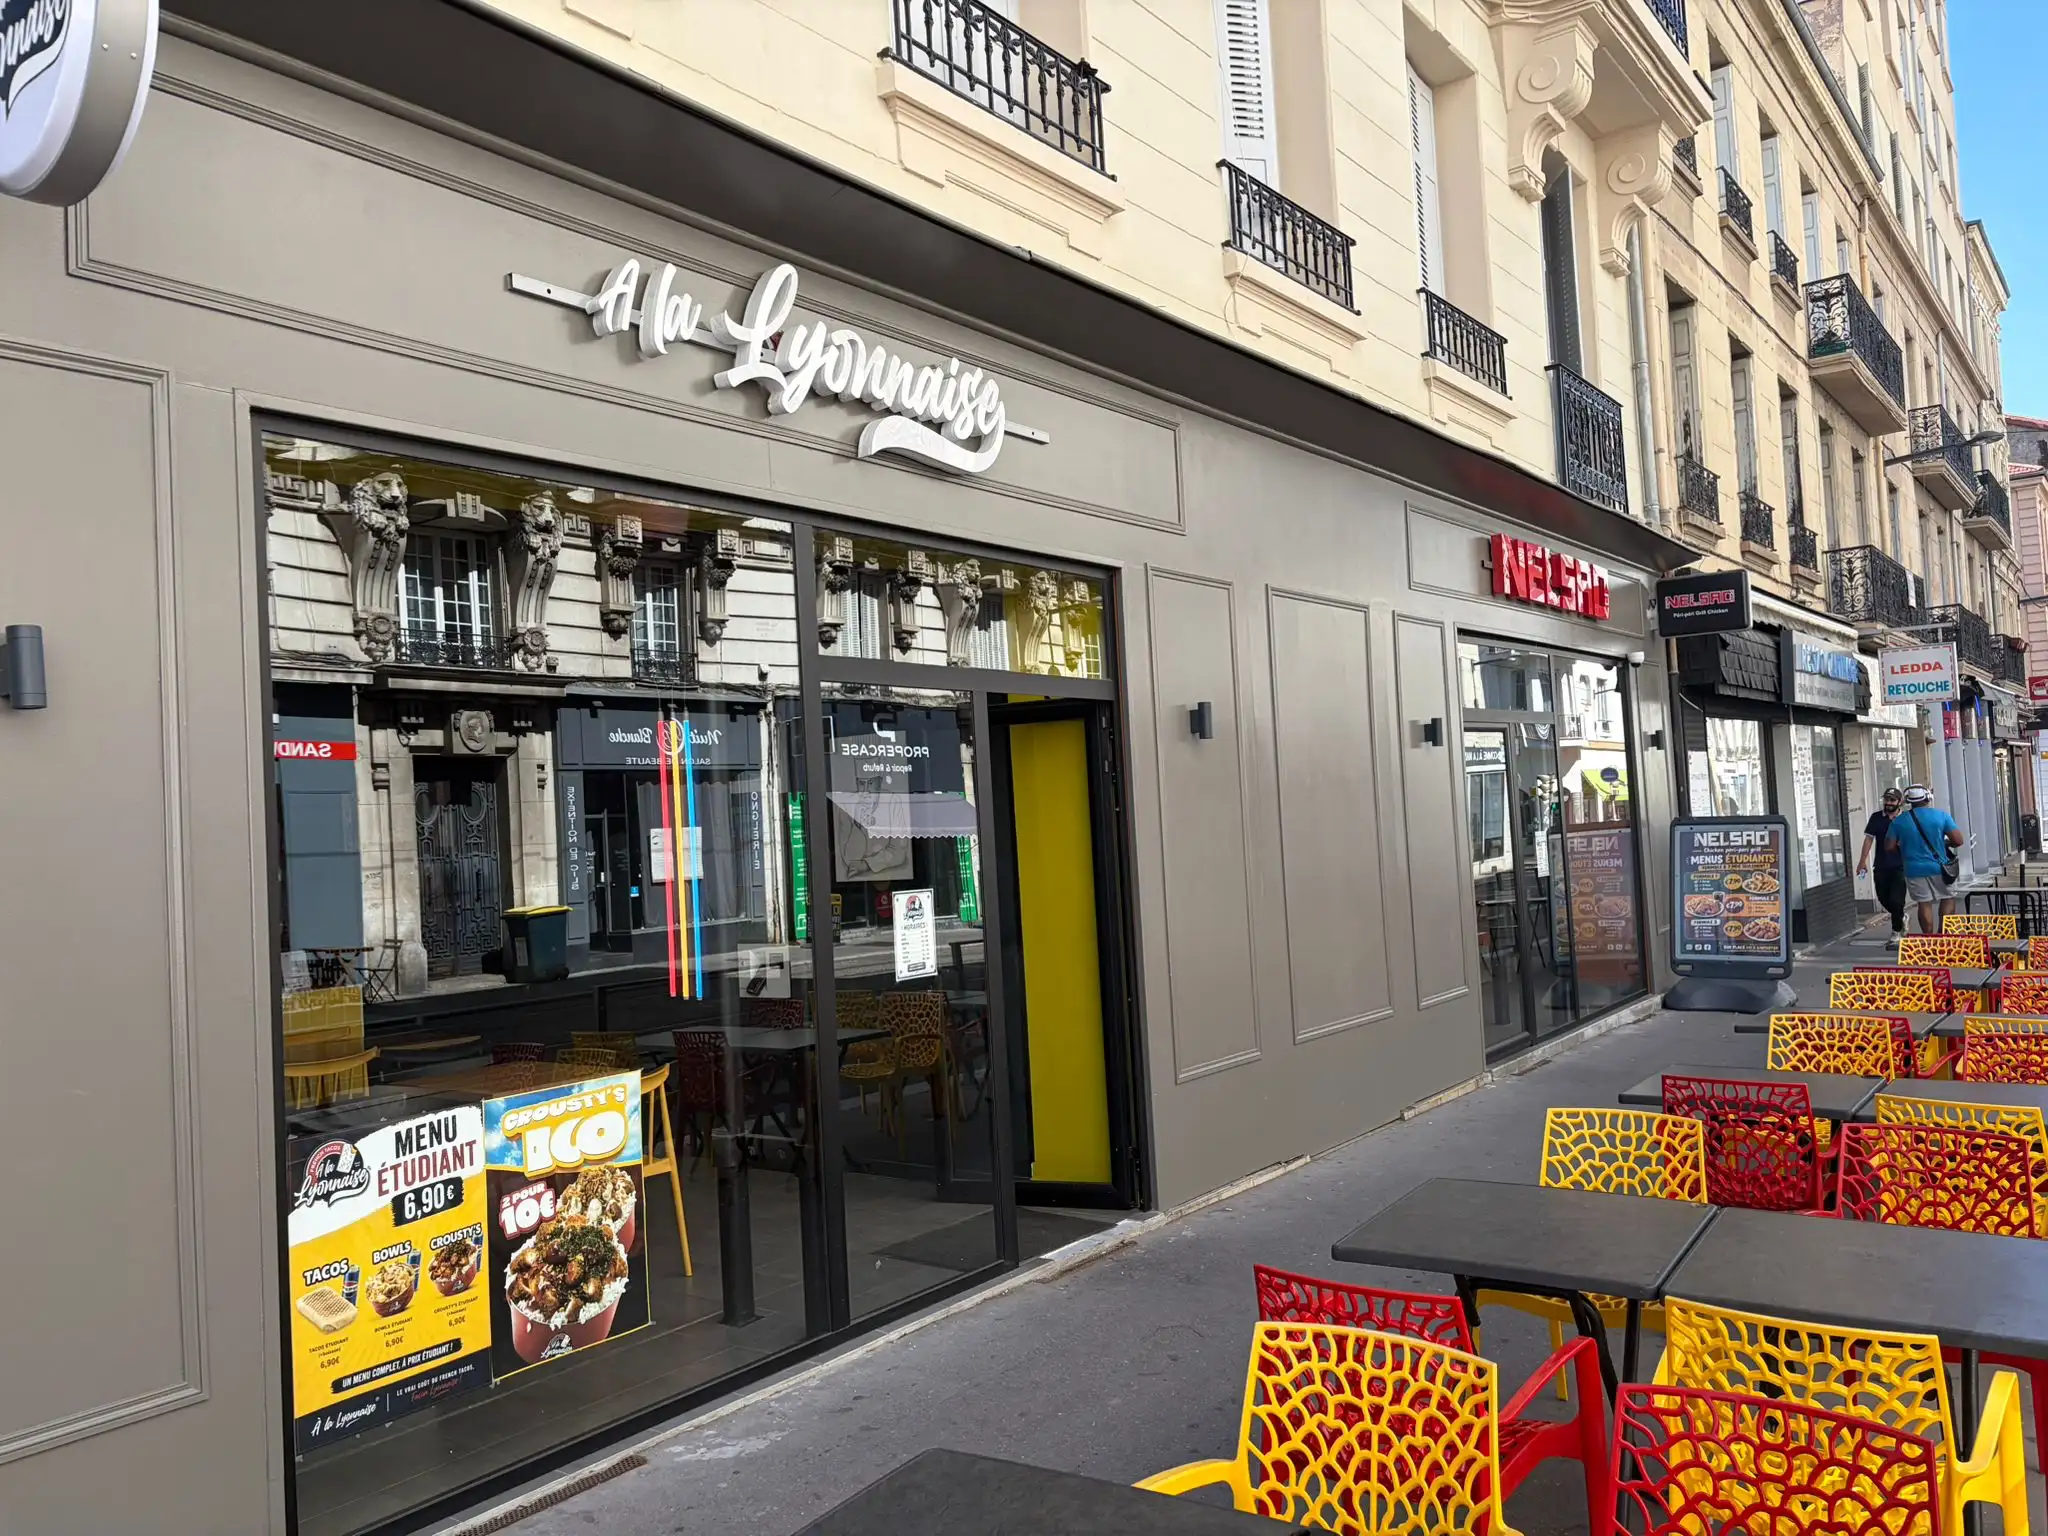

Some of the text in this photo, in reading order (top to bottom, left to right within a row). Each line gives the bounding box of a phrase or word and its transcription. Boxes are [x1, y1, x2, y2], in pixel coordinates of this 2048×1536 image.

[586, 259, 1006, 473] A la Lyonnaise
[1890, 661, 1944, 675] LEDDA
[1887, 680, 1950, 696] RETOUCHE
[1690, 853, 1776, 865] MENUS ÉTUDIANTS
[504, 1087, 625, 1131] CROUSTY'S
[395, 1115, 457, 1159] MENU
[309, 1145, 341, 1173] FRENCH TACOS
[377, 1140, 477, 1197] ÉTUDIANT
[294, 1169, 370, 1206] Lyonnaise
[502, 1183, 546, 1209] 2 POUR
[501, 1191, 554, 1235] 10€
[430, 1223, 482, 1249] CROUSTY'S
[373, 1241, 411, 1264] BOWLS
[304, 1260, 349, 1285] TACOS
[309, 1345, 325, 1353] TACOS
[385, 1335, 404, 1348] 6,90€
[320, 1356, 340, 1369] 6,90€
[342, 1376, 352, 1388] UN
[353, 1371, 371, 1385] MENU
[401, 1358, 407, 1368] À
[407, 1354, 422, 1366] PRIX
[422, 1344, 449, 1361] ÉTUDIANT
[396, 1389, 403, 1397] LE
[404, 1384, 416, 1394] VRAI
[431, 1377, 439, 1385] DU
[439, 1370, 457, 1382] FRENCH
[311, 1402, 377, 1437] À la Lyonnaise
